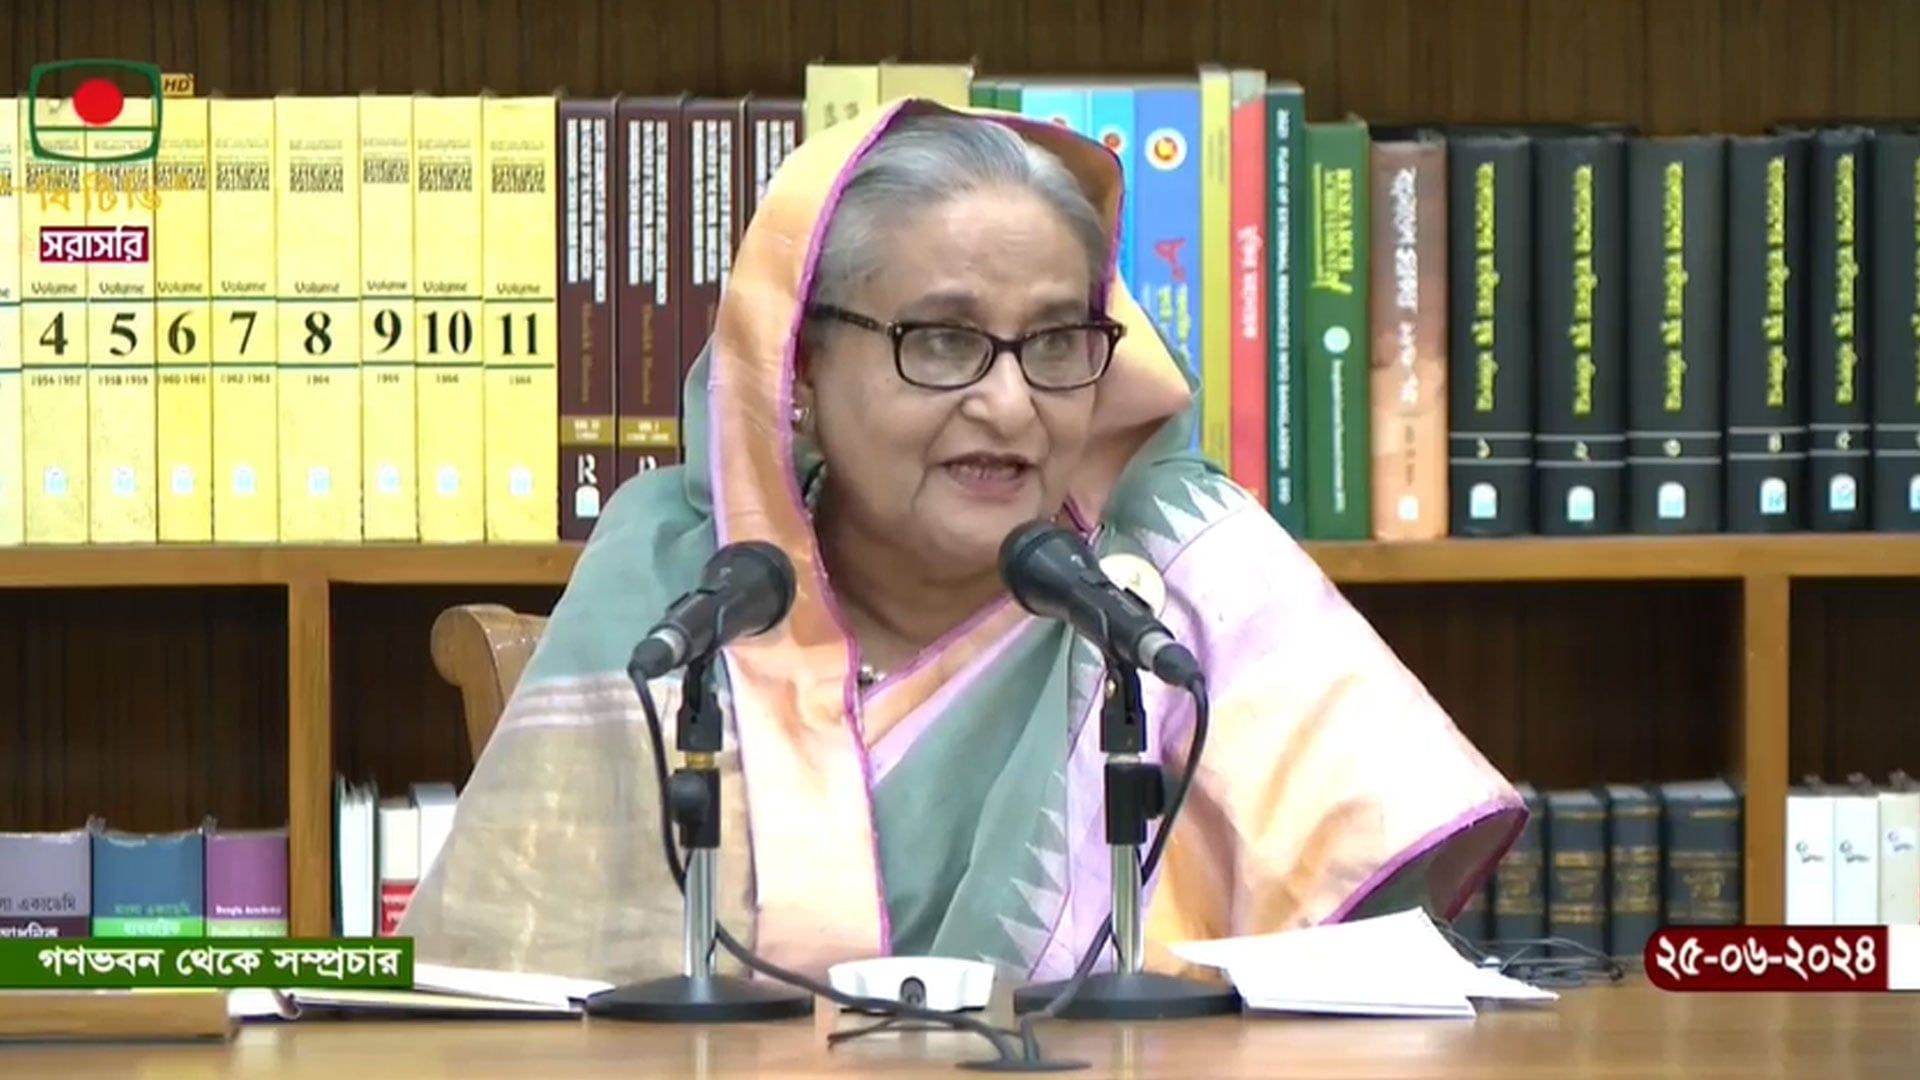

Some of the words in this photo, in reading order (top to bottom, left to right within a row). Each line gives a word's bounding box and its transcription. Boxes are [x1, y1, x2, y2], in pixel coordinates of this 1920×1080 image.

[1276, 146, 1291, 183] FLOW
[1276, 186, 1291, 204] OF
[1276, 206, 1291, 271] EXTERNAL
[1338, 168, 1354, 271] RESEARCH
[32, 282, 77, 294] Volume
[99, 283, 144, 294] Volume
[158, 282, 202, 293] Volume
[221, 280, 266, 292] Volume
[295, 281, 340, 293] Volume
[367, 279, 408, 291] Volume
[423, 281, 468, 293] Volume
[497, 282, 541, 294] Volume
[39, 311, 68, 356] 4
[168, 310, 196, 356] 6
[230, 311, 257, 355] 7
[304, 311, 332, 356] 8
[374, 309, 402, 354] 9
[424, 310, 472, 355] 10
[1276, 274, 1291, 349] RESOURCES
[110, 312, 138, 356] 5
[500, 312, 538, 356] 11
[1276, 351, 1291, 381] INTO
[1276, 384, 1291, 469] BANGLADESH
